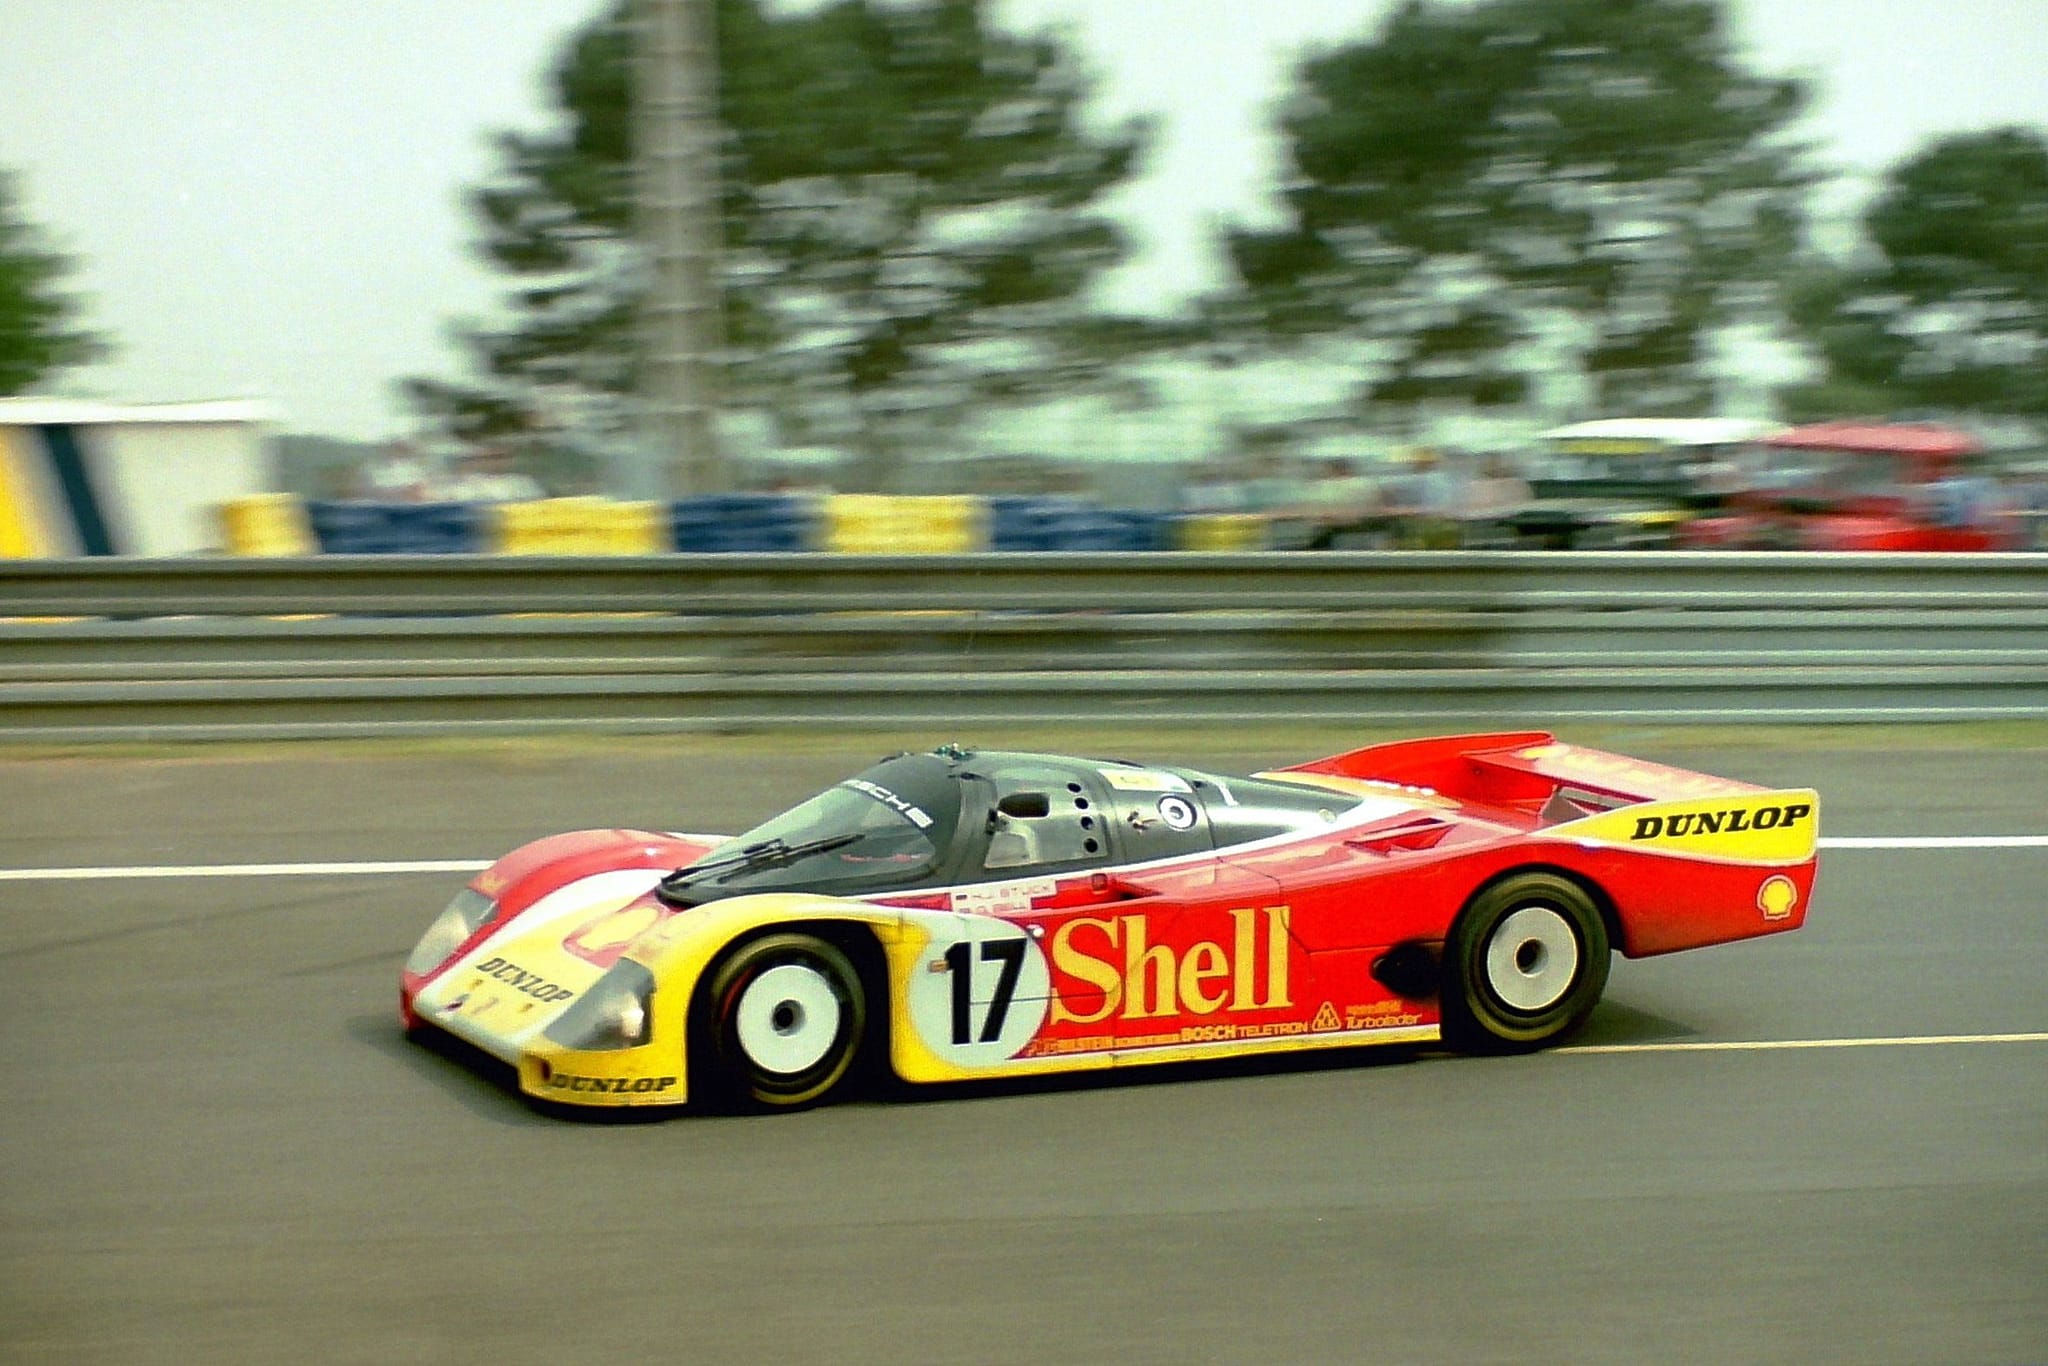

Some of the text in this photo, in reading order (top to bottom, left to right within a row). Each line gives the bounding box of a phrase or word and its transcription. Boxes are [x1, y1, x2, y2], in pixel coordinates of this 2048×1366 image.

[1631, 804, 1811, 841] DUNLOP
[476, 957, 573, 1003] DUNLOP
[1051, 905, 1294, 1025] Shell
[944, 938, 1028, 1046] 17
[1180, 1024, 1237, 1043] BOSCH
[1237, 1021, 1308, 1038] TELETRON
[551, 1073, 676, 1093] DUNLOP
